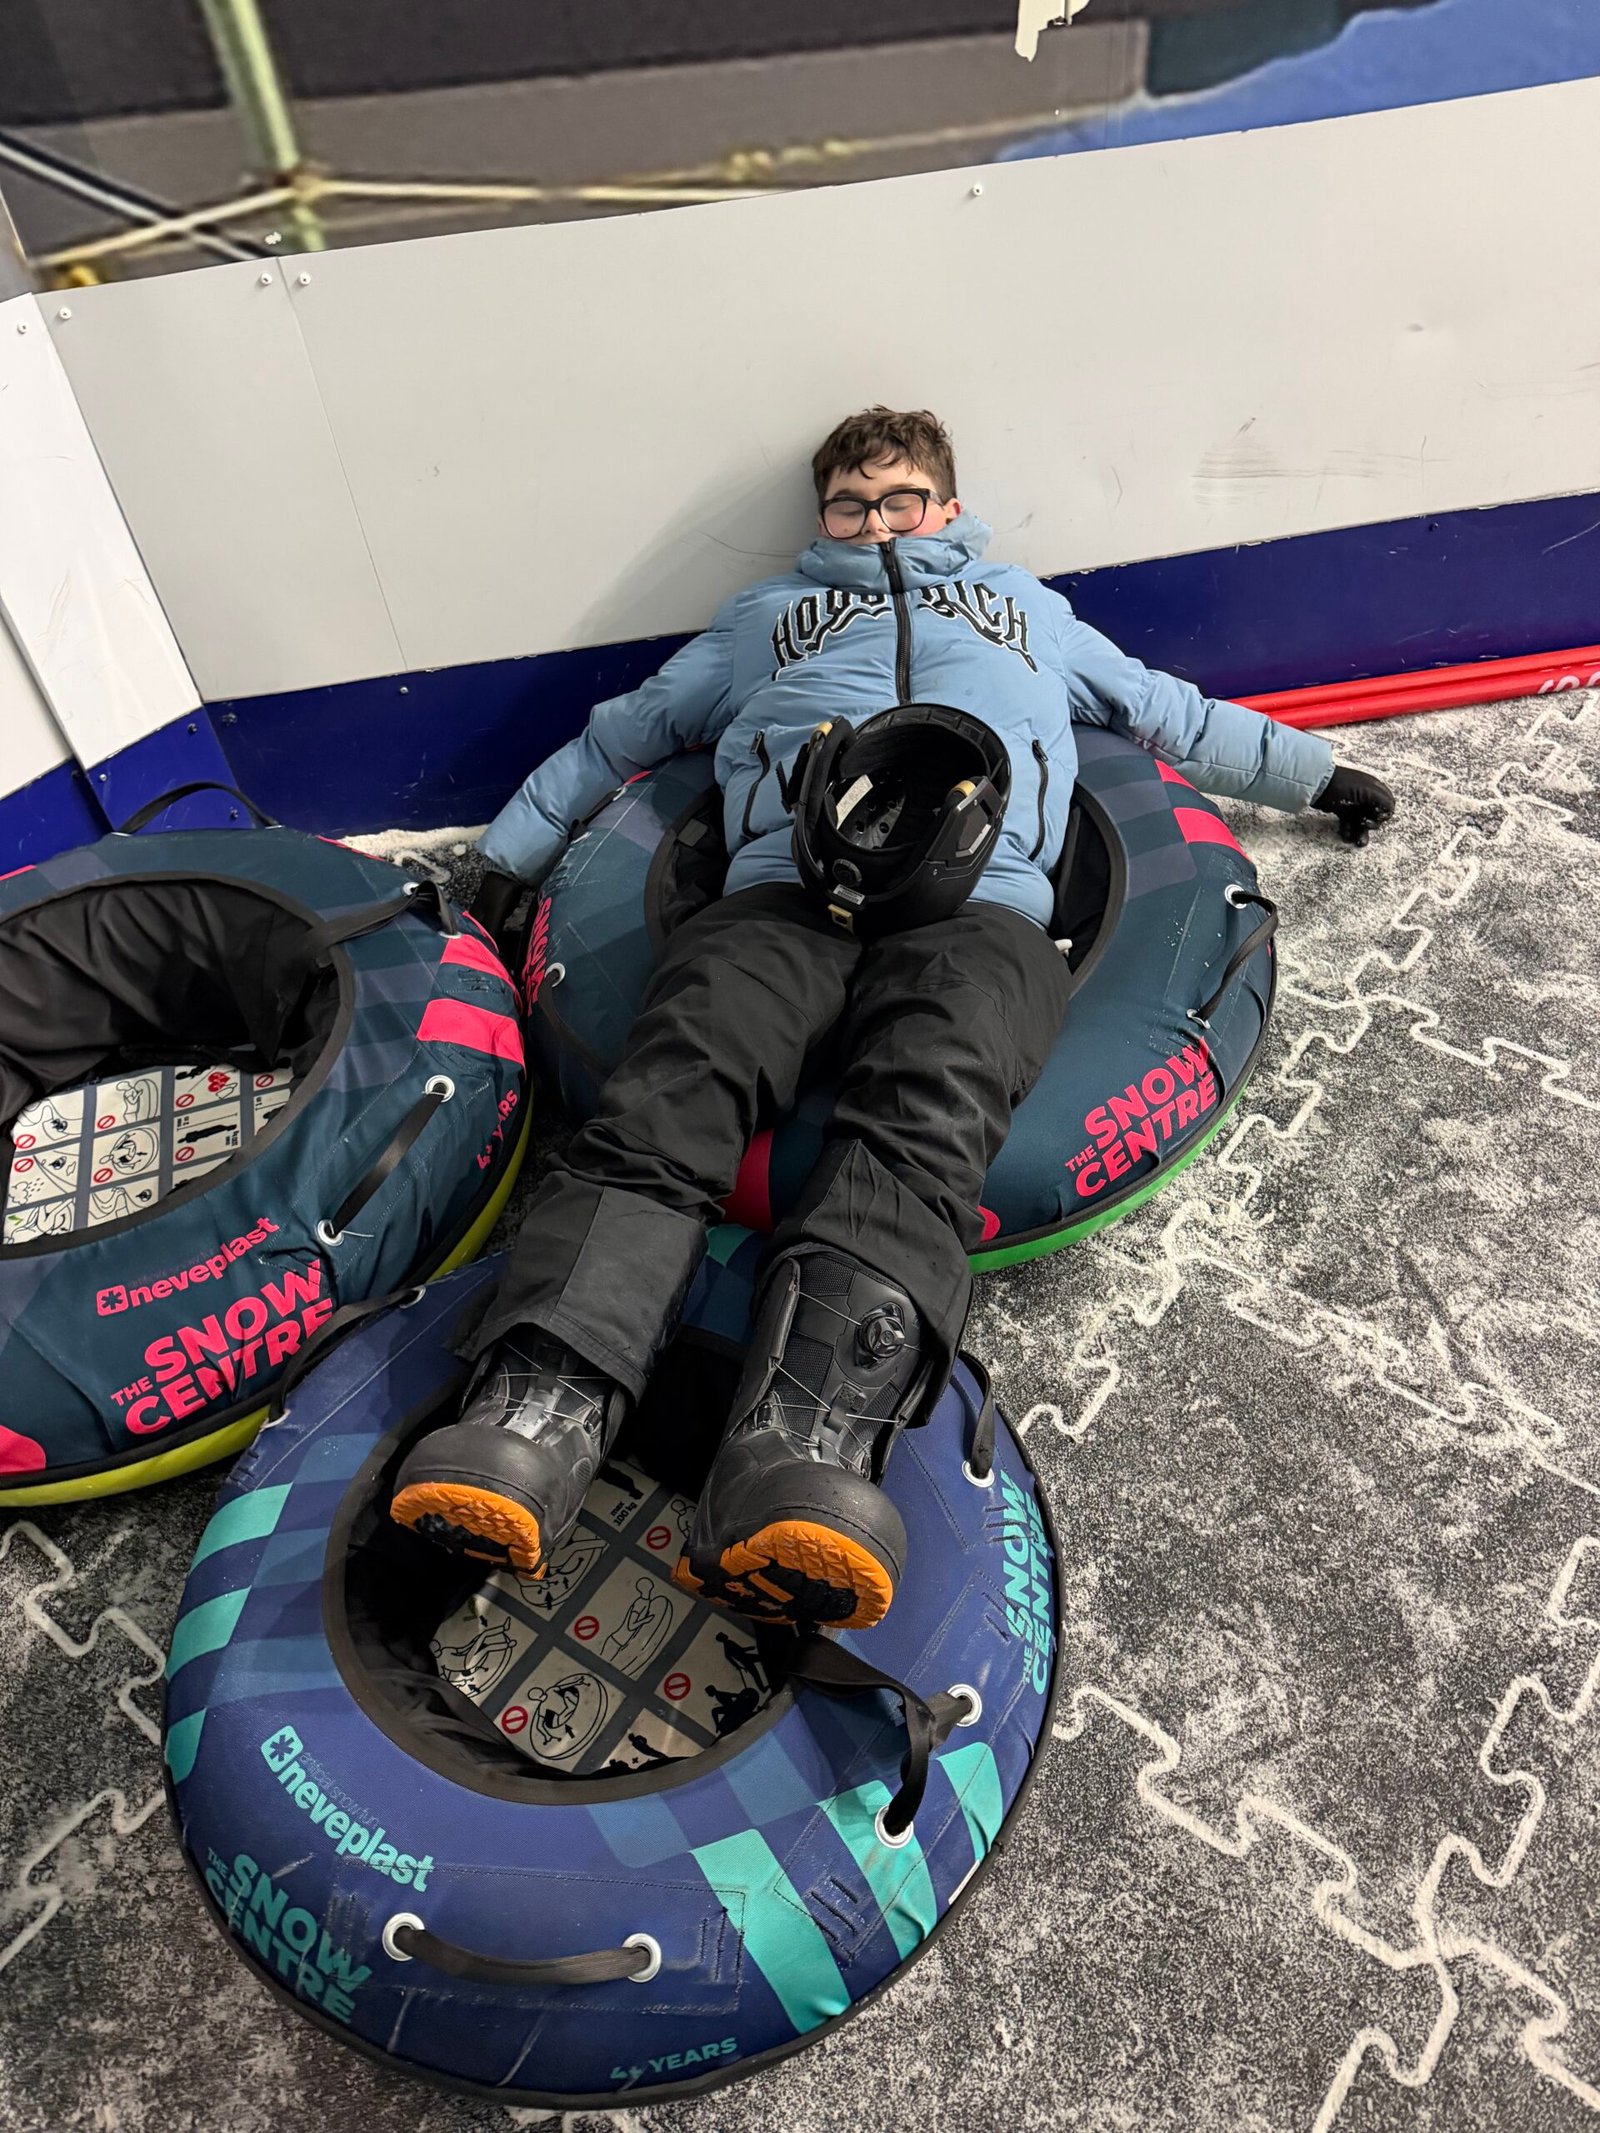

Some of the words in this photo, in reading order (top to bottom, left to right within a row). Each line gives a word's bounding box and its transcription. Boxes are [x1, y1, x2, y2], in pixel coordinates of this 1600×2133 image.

[1075, 1071, 1217, 1198] CENTRE
[1084, 1036, 1210, 1150] SNOW
[1065, 1144, 1098, 1172] THE
[129, 1217, 280, 1308] neveplast
[144, 1258, 321, 1383] SNOW
[111, 1376, 153, 1406] THE
[125, 1298, 333, 1435] CENTRE
[614, 1509, 629, 1526] 100
[1000, 1469, 1033, 1643] SNOW
[1025, 1491, 1052, 1695] CENTRE
[1023, 1646, 1033, 1684] THE
[207, 1847, 229, 1879] THE
[277, 1760, 435, 1893] neveplast
[205, 1867, 357, 2024] CENTRE
[229, 1854, 373, 1993] SNOW
[648, 2036, 739, 2073] YEARS
